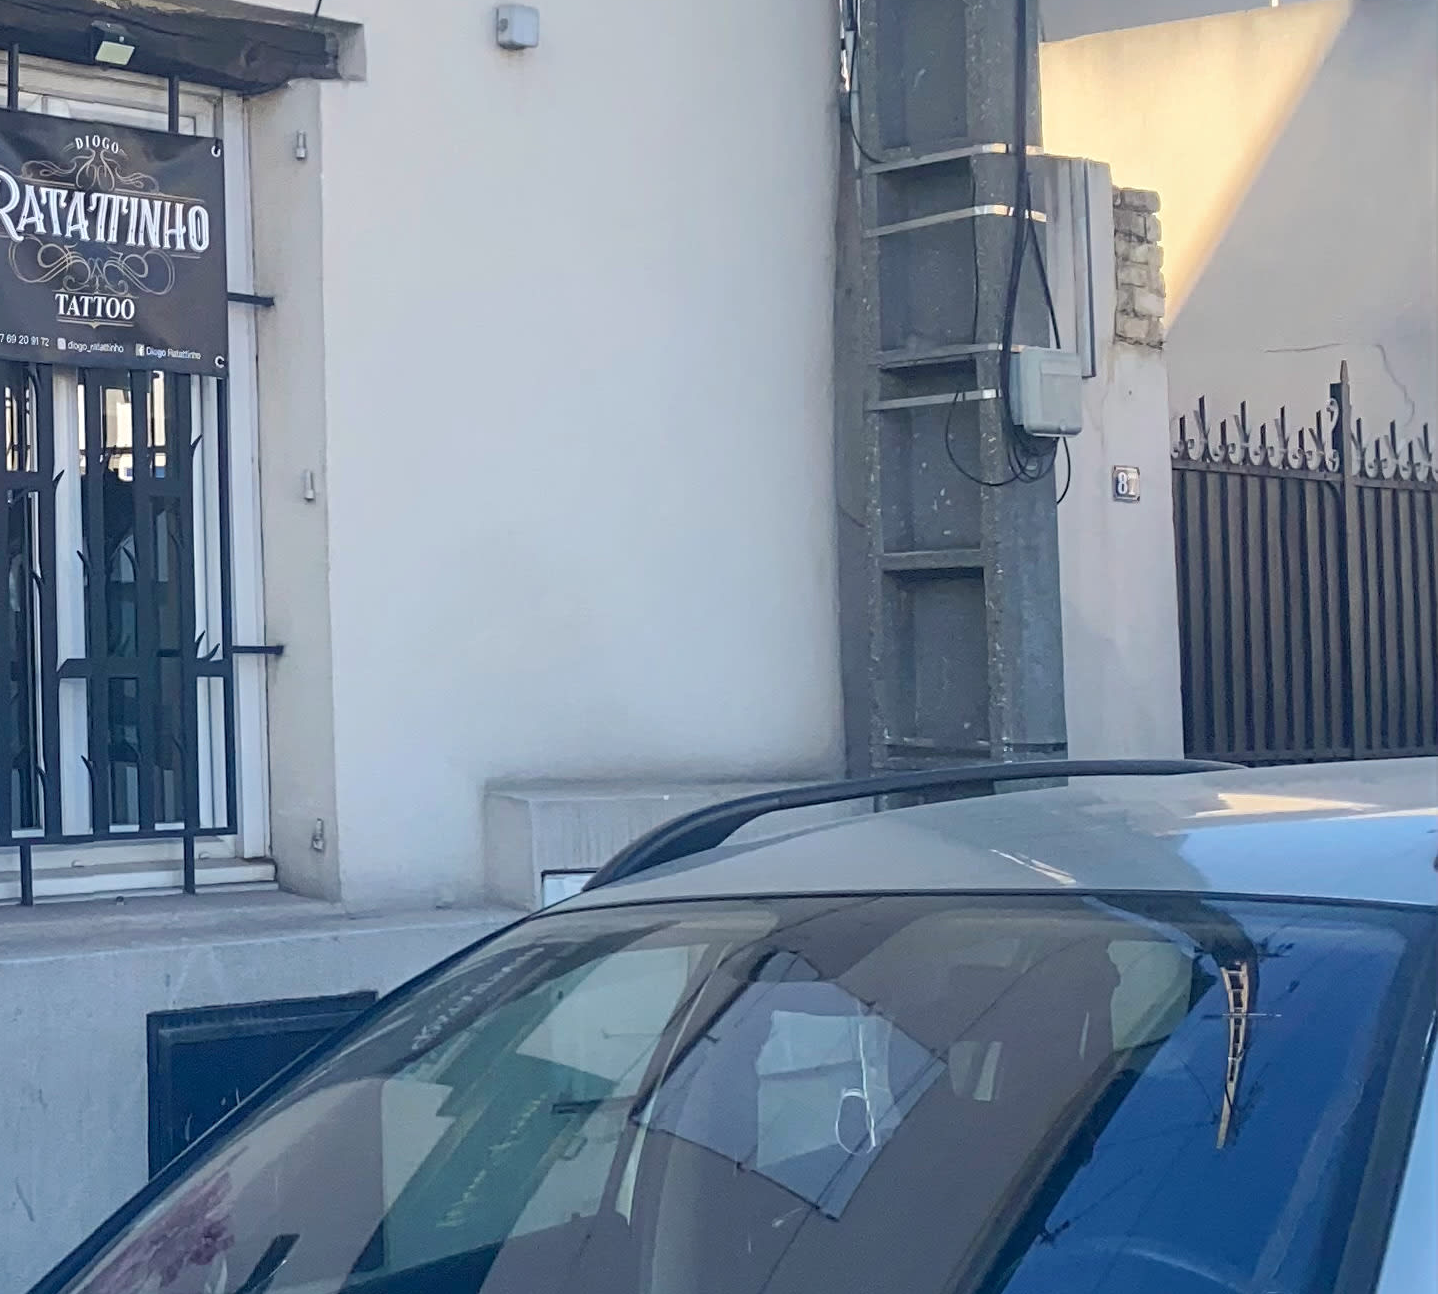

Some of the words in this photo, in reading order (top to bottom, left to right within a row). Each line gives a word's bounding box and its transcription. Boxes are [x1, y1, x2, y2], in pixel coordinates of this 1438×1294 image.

[75, 135, 119, 155] DIOGO
[55, 293, 136, 320] TATTOO
[18, 335, 29, 345] 20
[146, 346, 166, 358] Diogo
